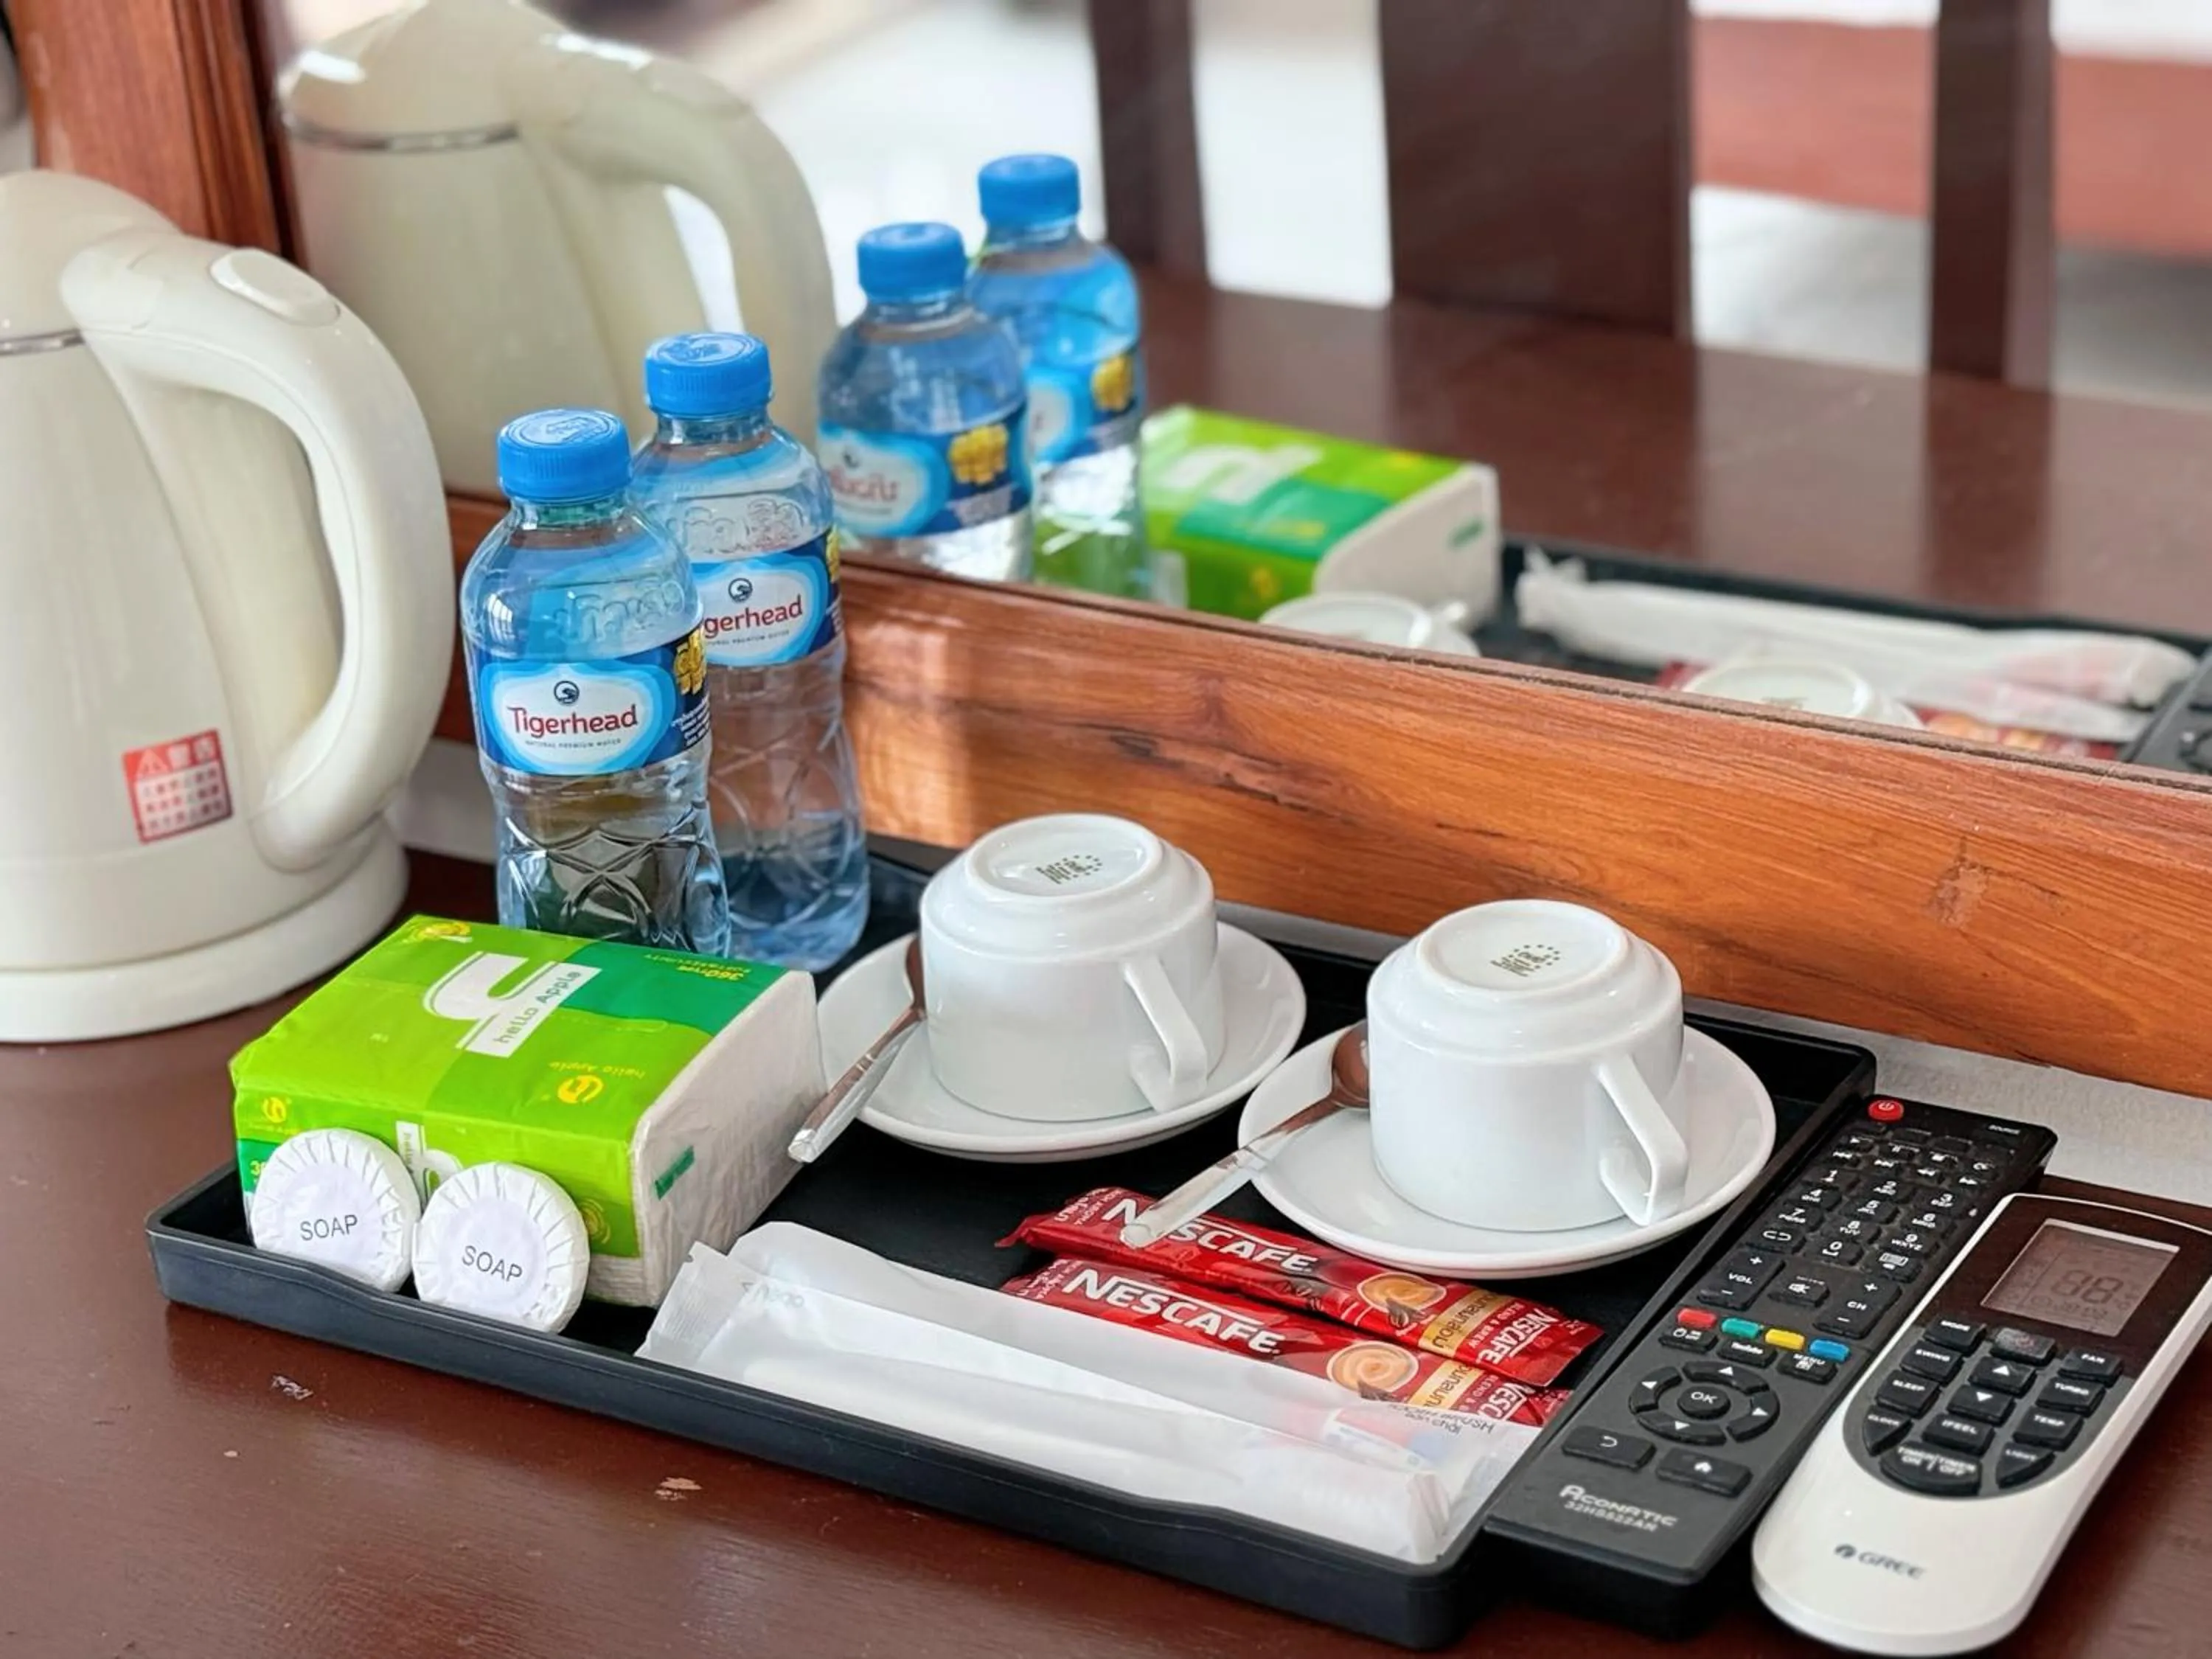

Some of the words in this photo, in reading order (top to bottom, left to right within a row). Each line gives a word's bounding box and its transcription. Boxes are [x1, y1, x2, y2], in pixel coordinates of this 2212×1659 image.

[703, 593, 803, 639] gerhead
[507, 703, 639, 738] Tigerhead
[492, 1007, 539, 1043] hello
[535, 971, 582, 1004] Apple
[300, 1214, 359, 1242] SOAP
[1102, 1198, 1318, 1273] NSCAFE
[462, 1245, 524, 1283] SOAP
[1728, 1272, 1753, 1285] VOL
[1846, 1301, 1868, 1311] CH
[2081, 1353, 2106, 1364] FAN
[1477, 1382, 1536, 1421] NESC
[1691, 1391, 1717, 1404] OK
[2054, 1382, 2090, 1396] TURBO
[2034, 1414, 2065, 1427] TEMP
[1858, 1550, 1928, 1581] GREE
